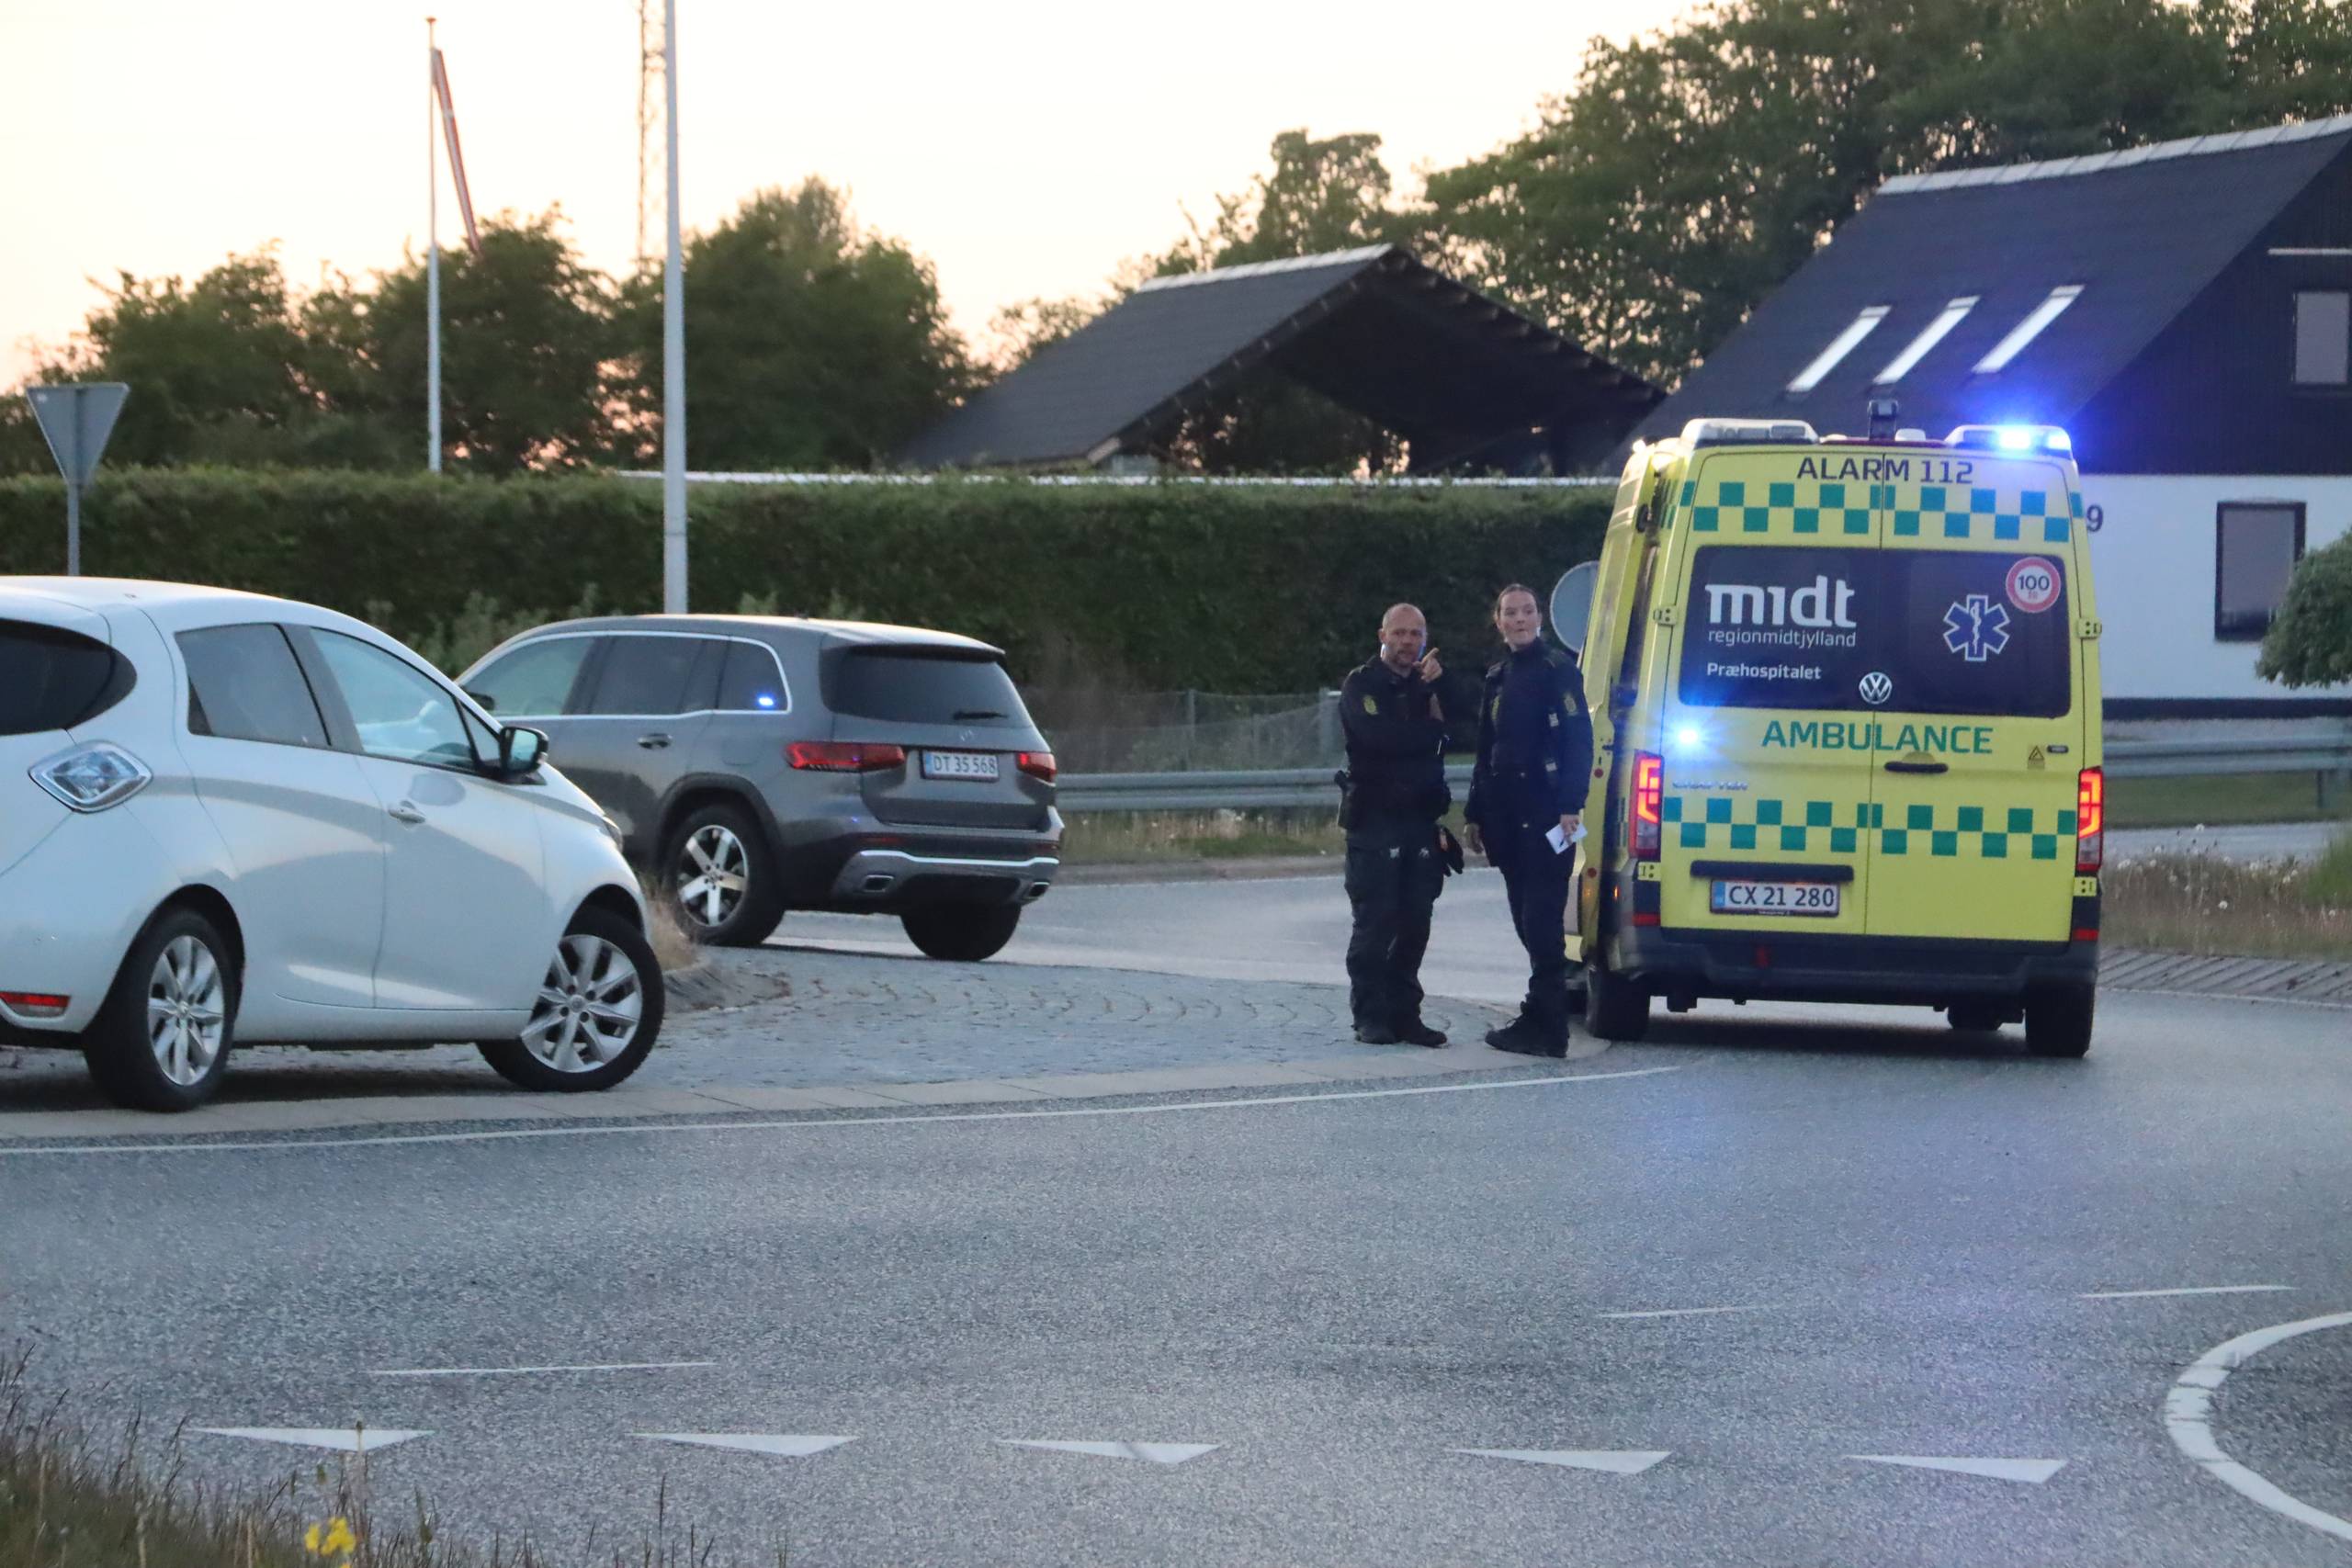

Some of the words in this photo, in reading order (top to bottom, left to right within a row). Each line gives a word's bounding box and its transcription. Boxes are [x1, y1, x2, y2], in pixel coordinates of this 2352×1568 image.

[1796, 457, 1909, 481] ALARM
[1920, 460, 1973, 484] 112
[2018, 575, 2050, 591] 100
[1704, 575, 1857, 627] midt
[1708, 628, 1857, 649] regionmidtjylland
[1706, 662, 1822, 681] Præhospitalet
[1761, 720, 1994, 754] AMBULANCE
[933, 756, 950, 772] DT
[955, 756, 970, 773] 35
[973, 757, 997, 773] 568
[1729, 886, 1757, 905] CX
[1764, 886, 1786, 906] 21
[1794, 887, 1835, 908] 280
